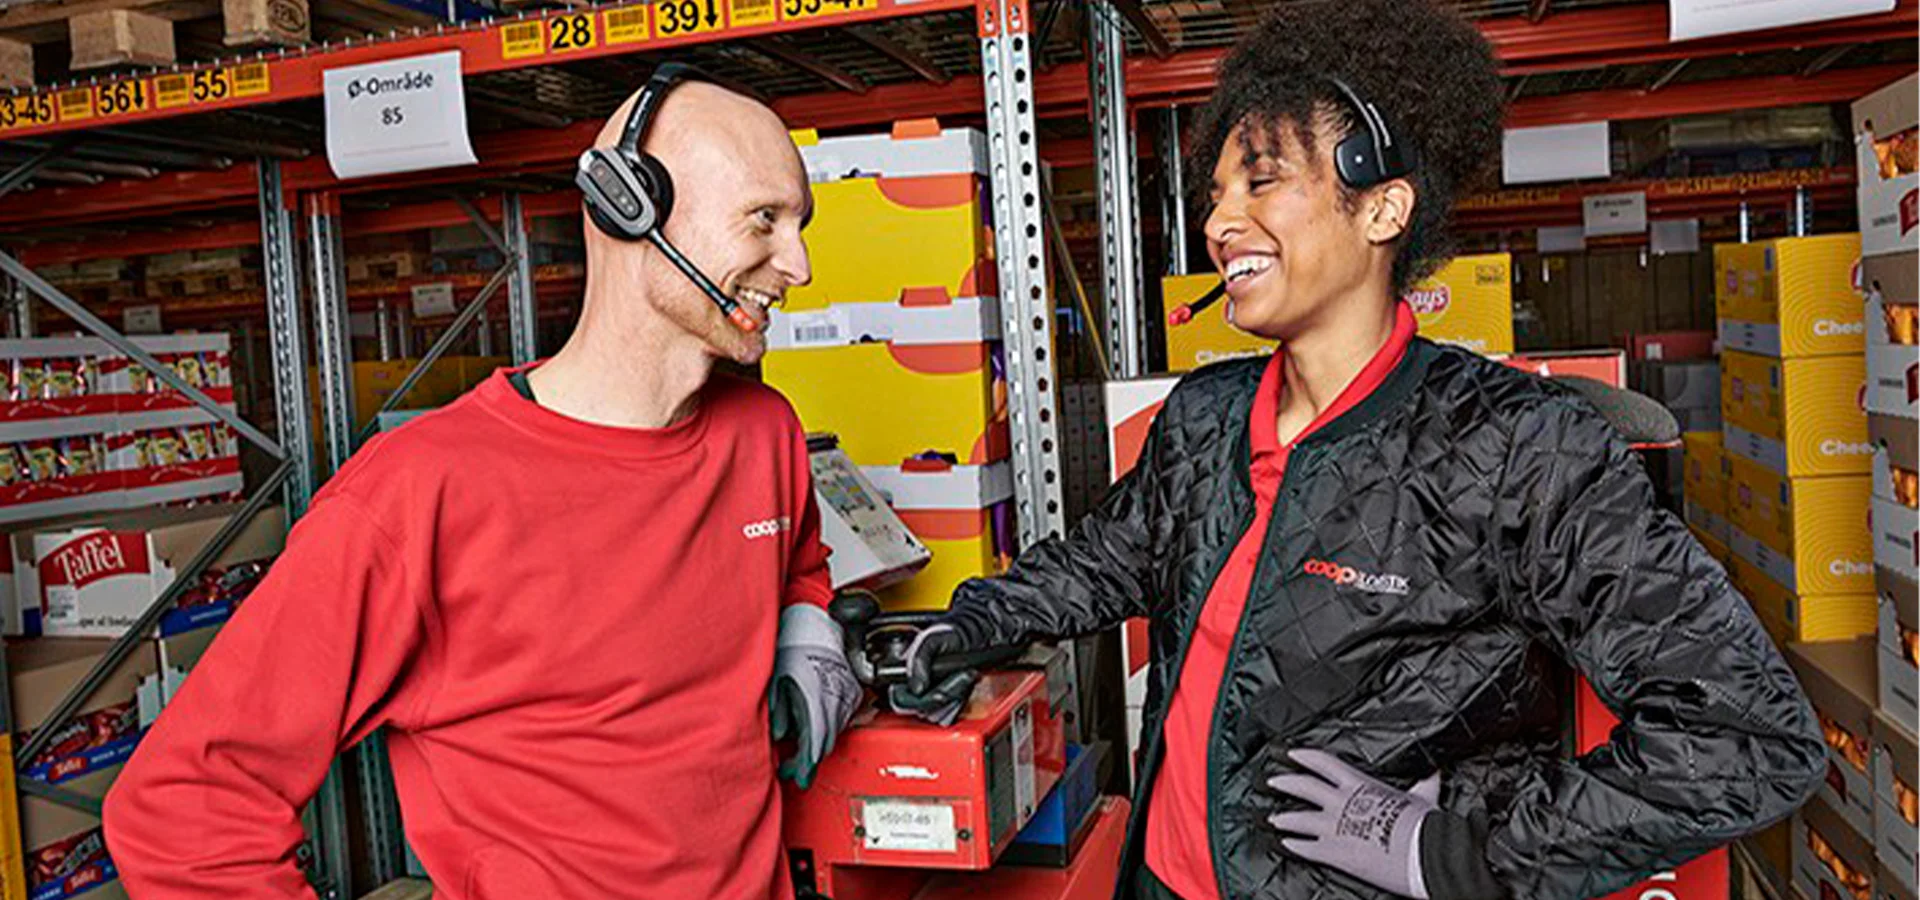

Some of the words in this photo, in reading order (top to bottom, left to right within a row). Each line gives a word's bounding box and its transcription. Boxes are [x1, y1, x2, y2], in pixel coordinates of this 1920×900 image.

[551, 14, 590, 48] 28
[660, 1, 699, 33] 39
[100, 82, 130, 113] 56
[194, 68, 226, 101] 55
[347, 72, 434, 99] Ø-Område
[0, 91, 52, 126] 3-45
[381, 106, 404, 125] 85
[743, 519, 778, 539] coop
[53, 535, 126, 584] Taffel
[1303, 558, 1357, 585] coop
